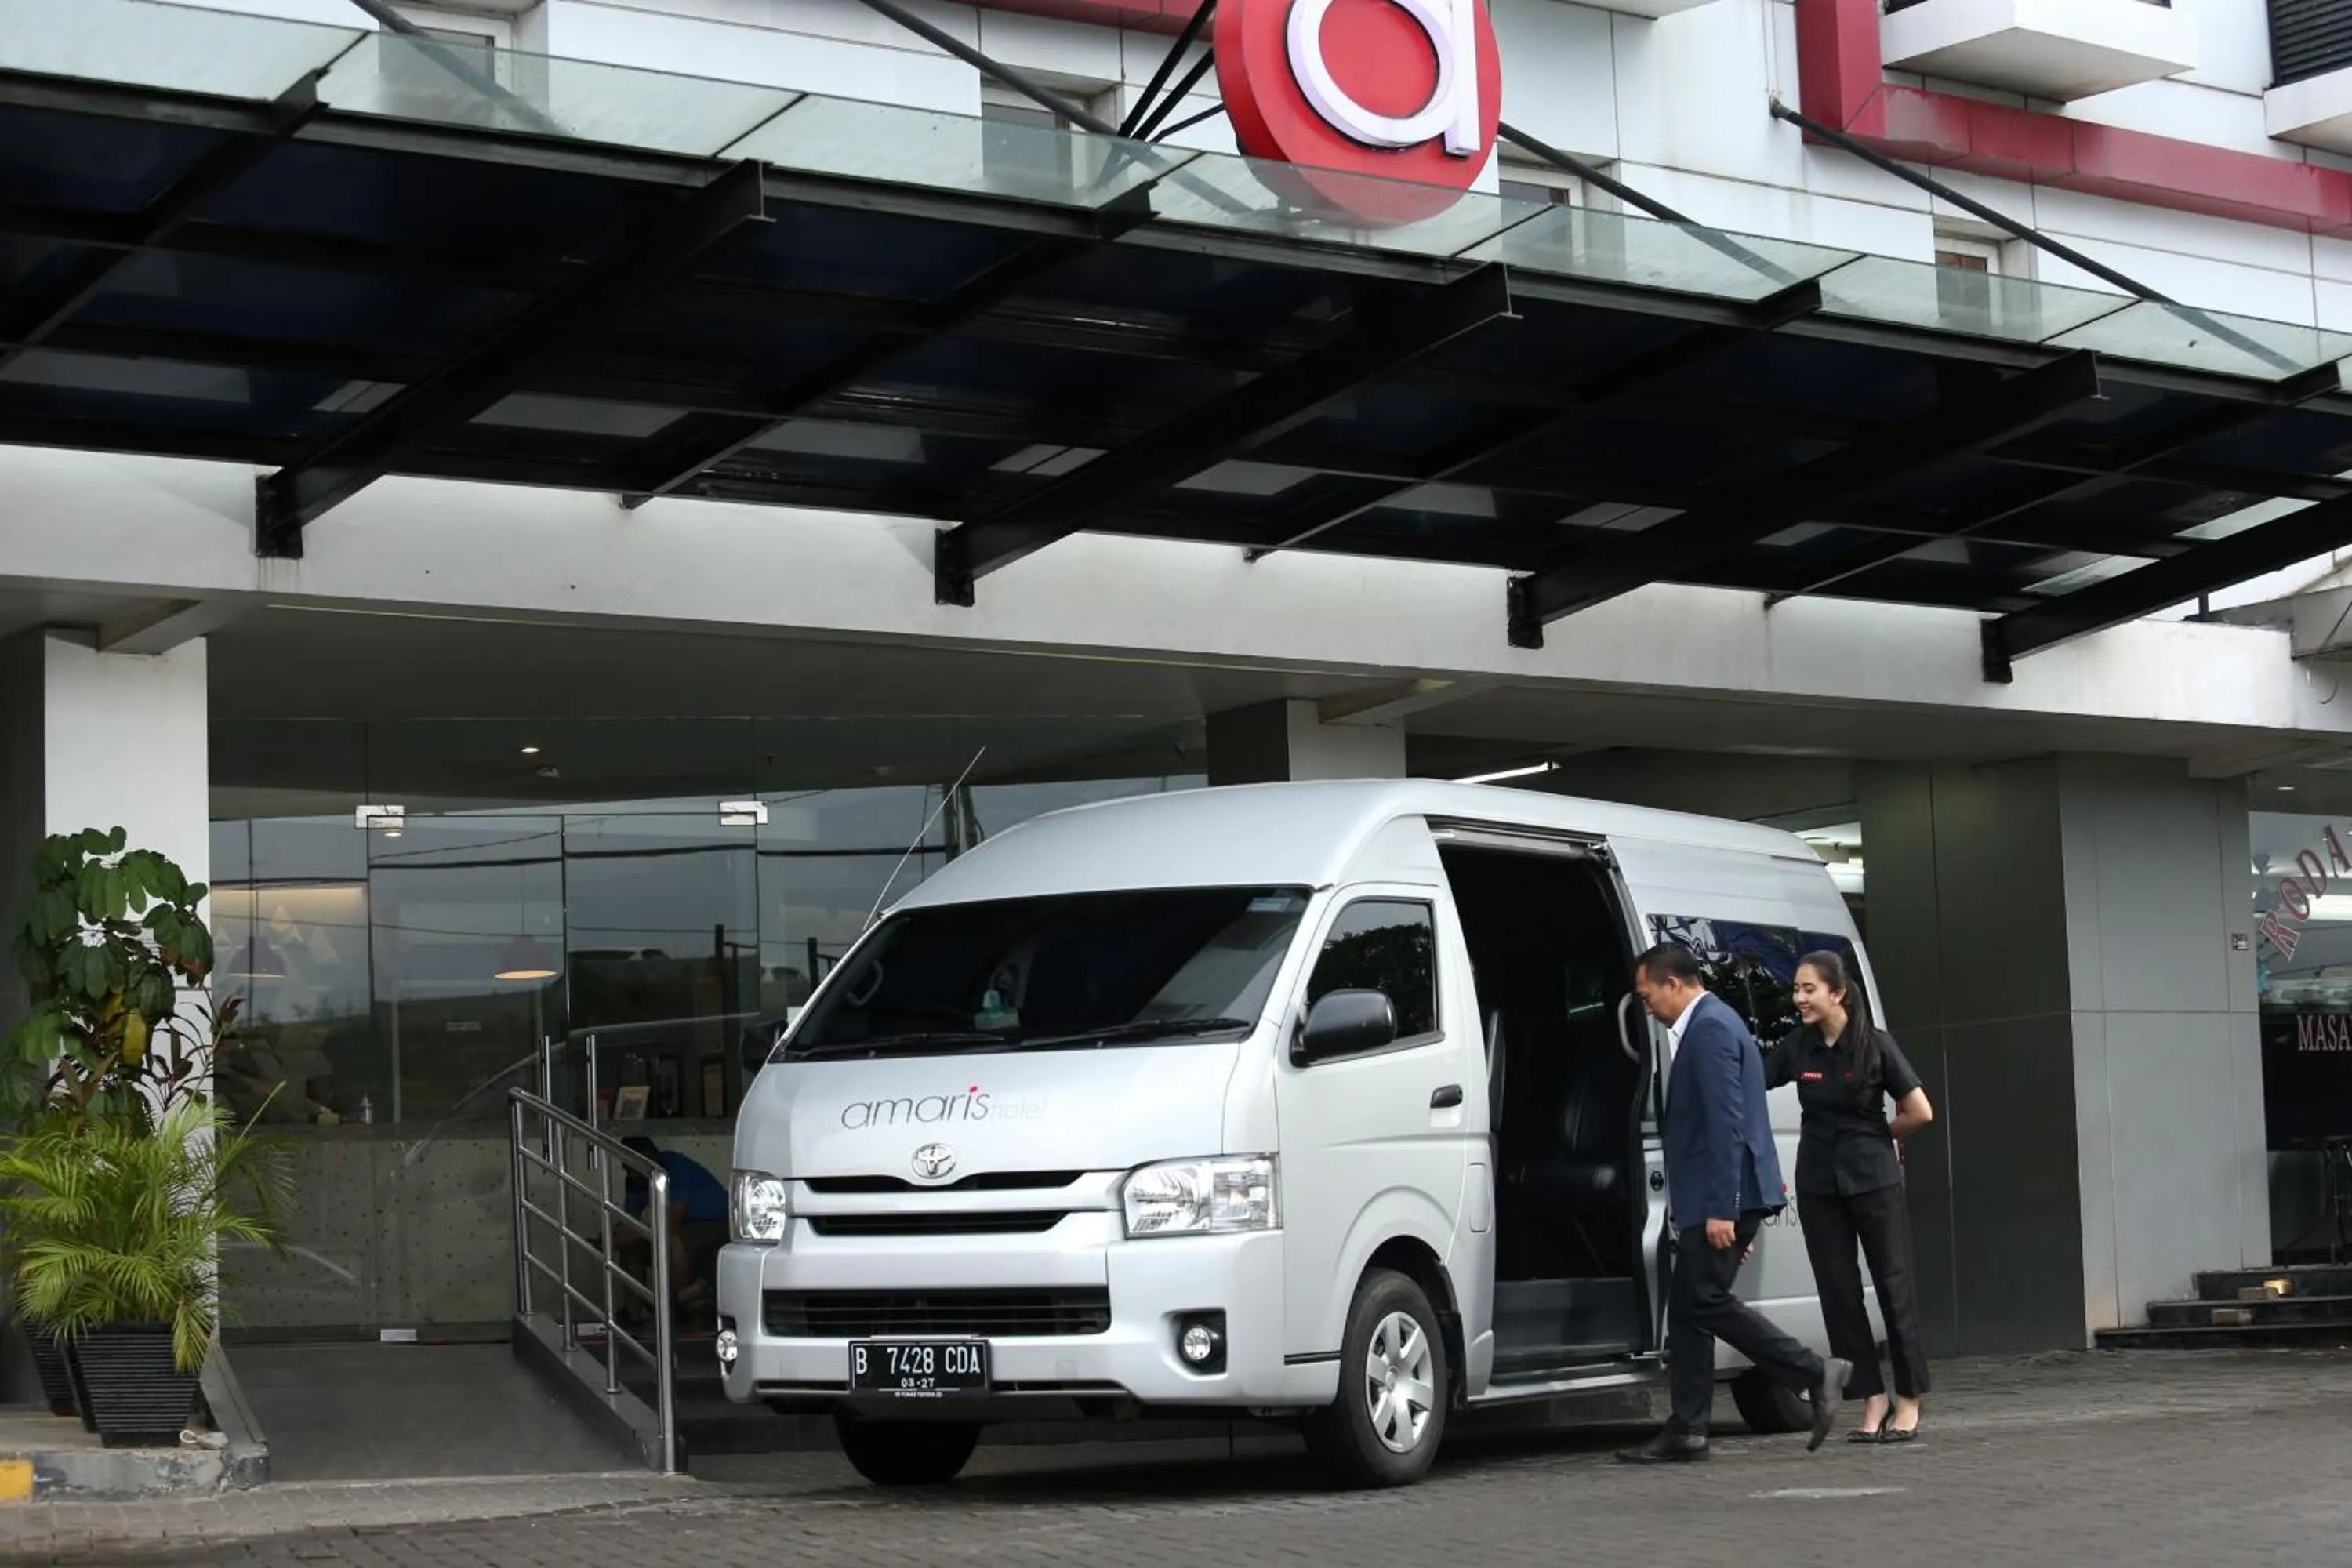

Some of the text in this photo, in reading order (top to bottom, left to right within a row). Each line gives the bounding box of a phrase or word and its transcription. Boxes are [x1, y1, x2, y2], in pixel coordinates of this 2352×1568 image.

[2260, 823, 2352, 962] RODA
[2296, 1014, 2352, 1051] MASA
[841, 1085, 990, 1130] amaris
[855, 1346, 981, 1374] B 7428 CDA
